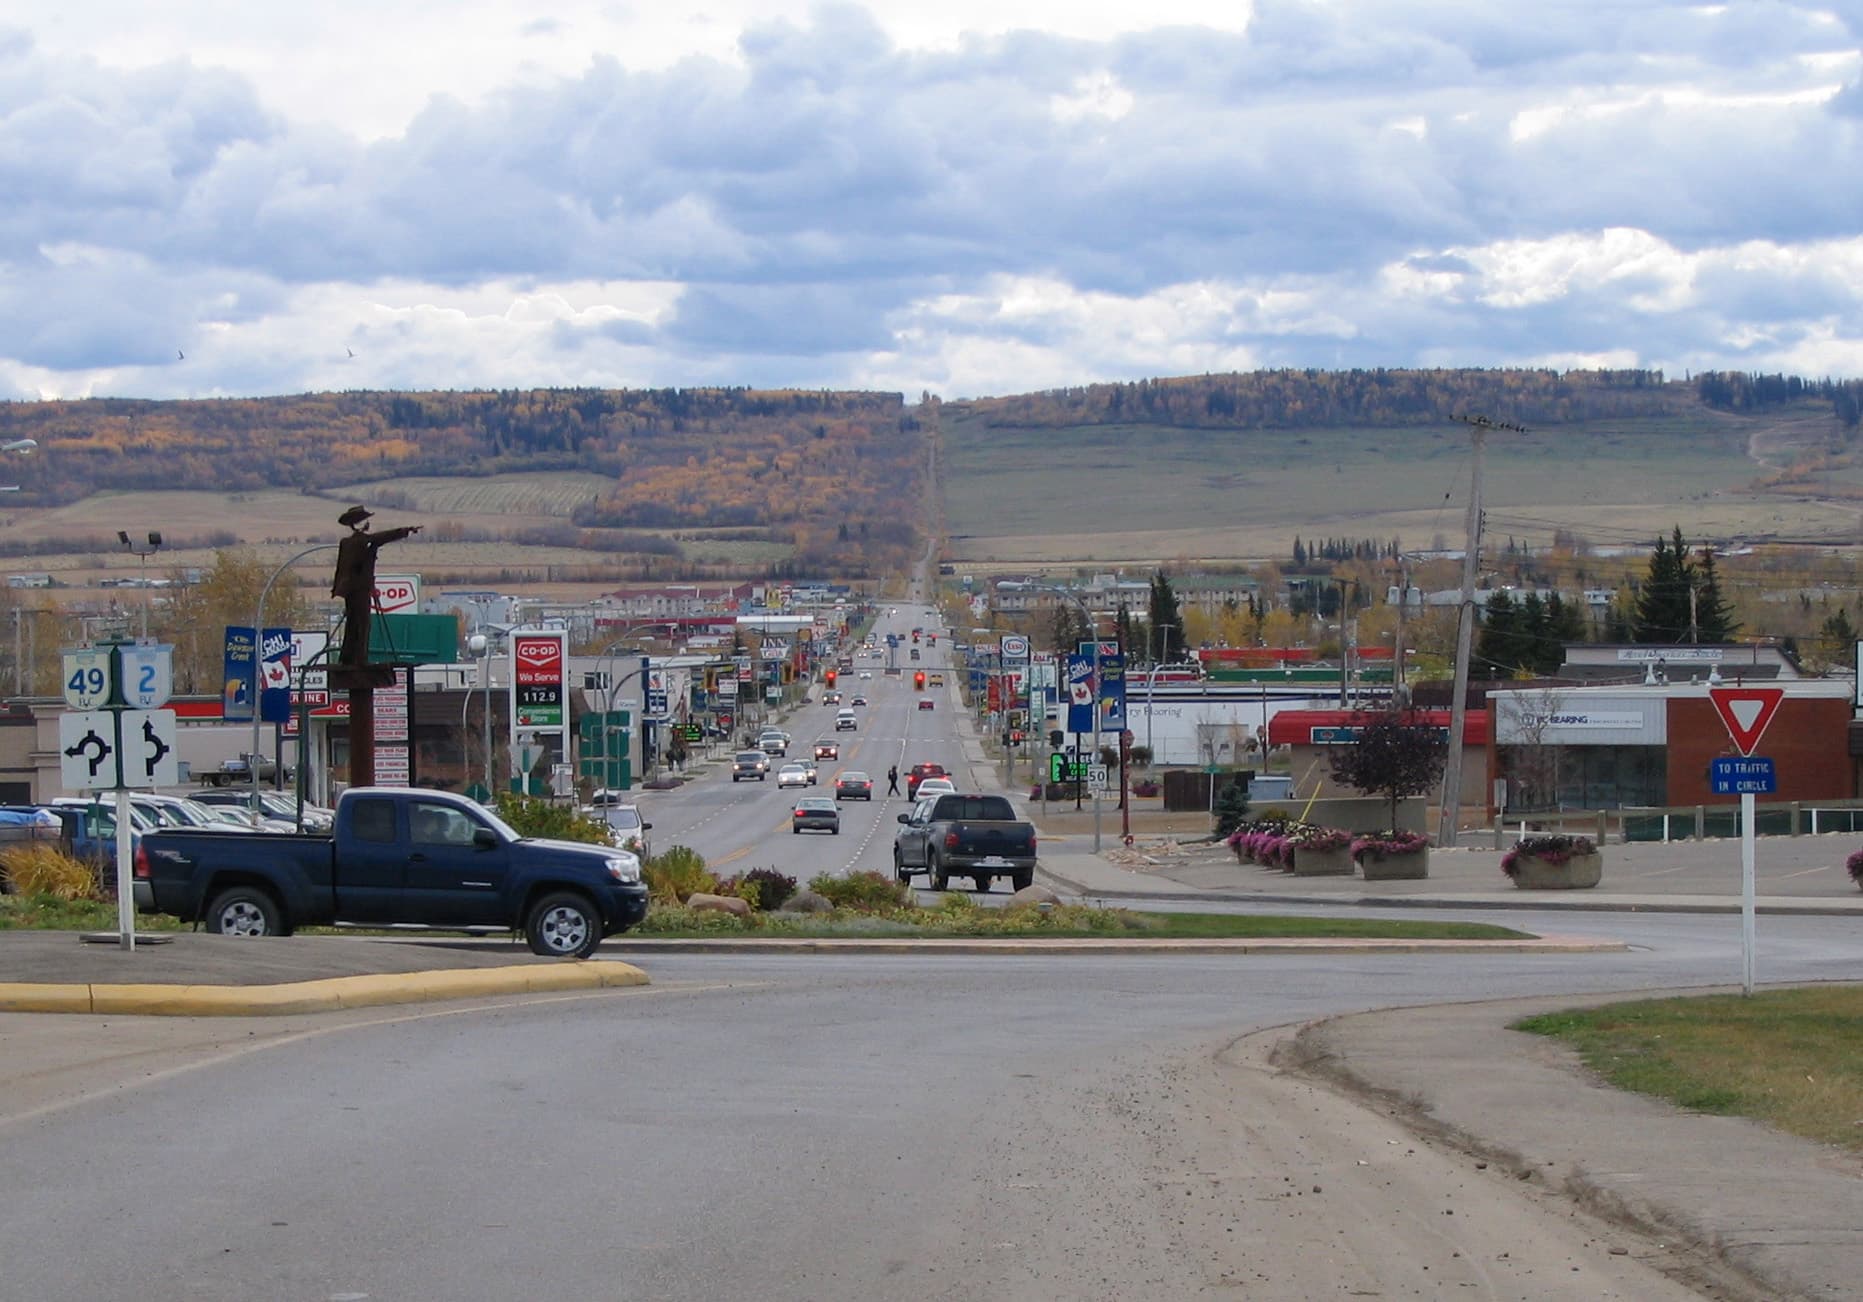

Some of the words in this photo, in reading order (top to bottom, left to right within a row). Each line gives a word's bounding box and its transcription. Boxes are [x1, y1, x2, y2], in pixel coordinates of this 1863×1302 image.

[371, 587, 408, 600] O-OP
[521, 646, 556, 656] CO-OP
[68, 668, 105, 695] 49
[139, 666, 156, 692] 2
[520, 672, 534, 681] We
[535, 672, 560, 681] Serve
[524, 692, 556, 702] 112.9
[1144, 706, 1182, 718] Flooring
[1549, 716, 1588, 724] BEARING
[1718, 764, 1731, 773] TO
[1735, 763, 1769, 773] TRAFFIC
[1089, 771, 1105, 782] 50
[1719, 782, 1729, 792] IN
[1736, 781, 1767, 791] CIRCLE
